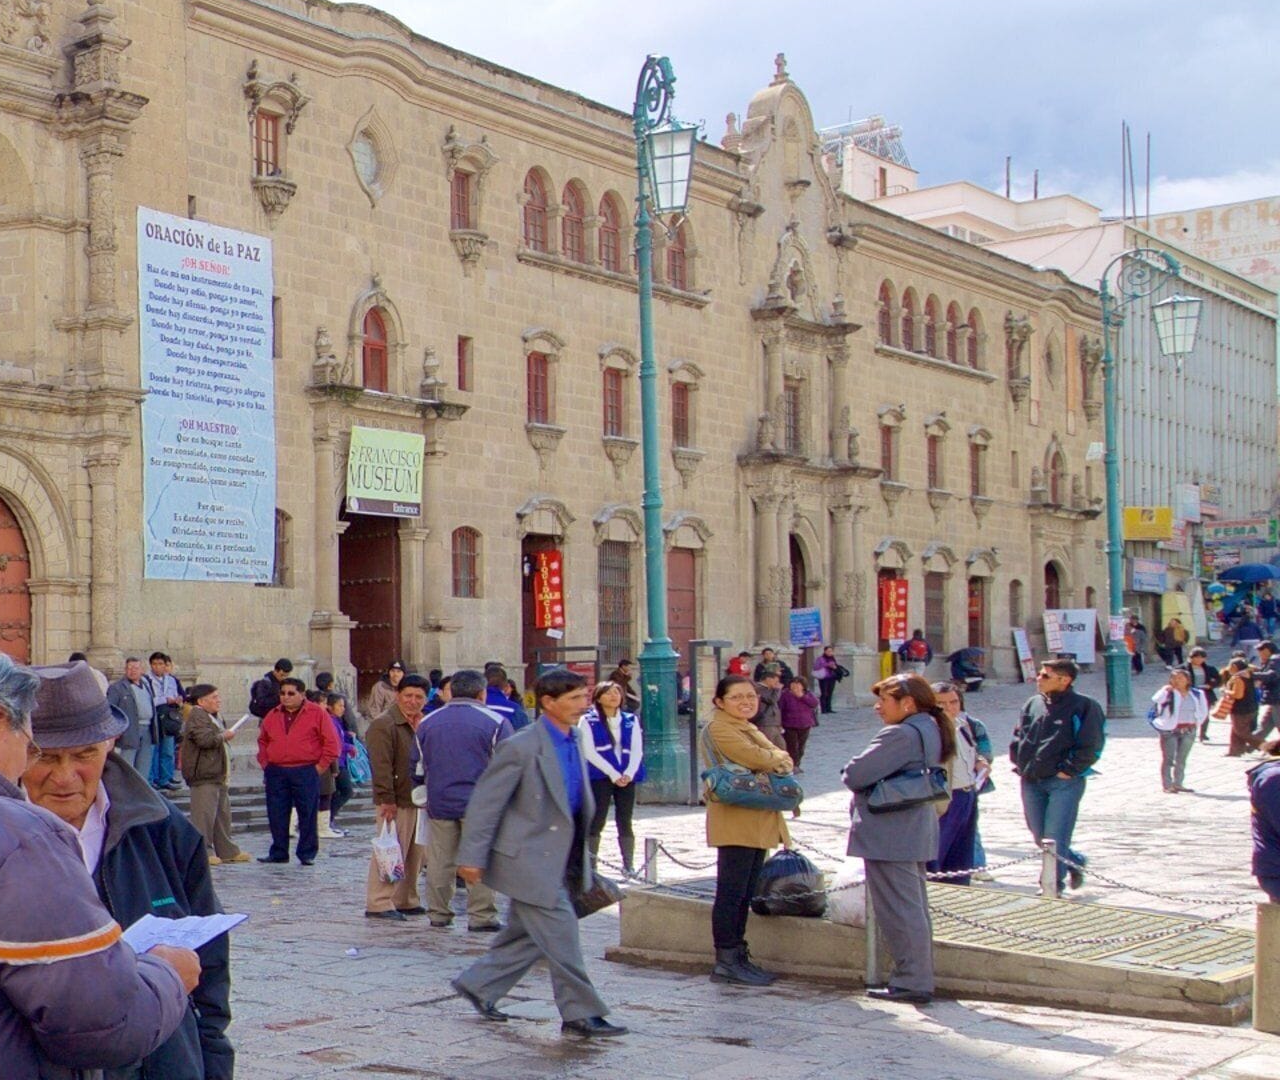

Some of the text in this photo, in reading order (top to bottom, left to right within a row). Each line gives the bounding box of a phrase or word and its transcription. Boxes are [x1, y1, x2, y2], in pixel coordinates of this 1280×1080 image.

[146, 223, 260, 261] ORACIÓN de la PAZ
[154, 279, 175, 290] Donde
[177, 284, 188, 295] hay
[148, 292, 169, 302] Donde
[171, 296, 183, 306] hay
[145, 304, 166, 314] Donde
[168, 308, 180, 320] hay
[151, 319, 172, 329] Donde
[174, 323, 185, 333] hay
[160, 334, 180, 344] Donde
[166, 348, 186, 358] Donde
[188, 352, 200, 363] hay
[149, 372, 170, 382] Donde
[172, 377, 183, 387] hay
[171, 389, 183, 399] hay
[359, 446, 421, 468] FRANCISCO
[350, 463, 419, 494] MUSEUM
[393, 502, 419, 515] Entrance
[1214, 526, 1258, 536] FEMA
[539, 592, 561, 601] SALE
